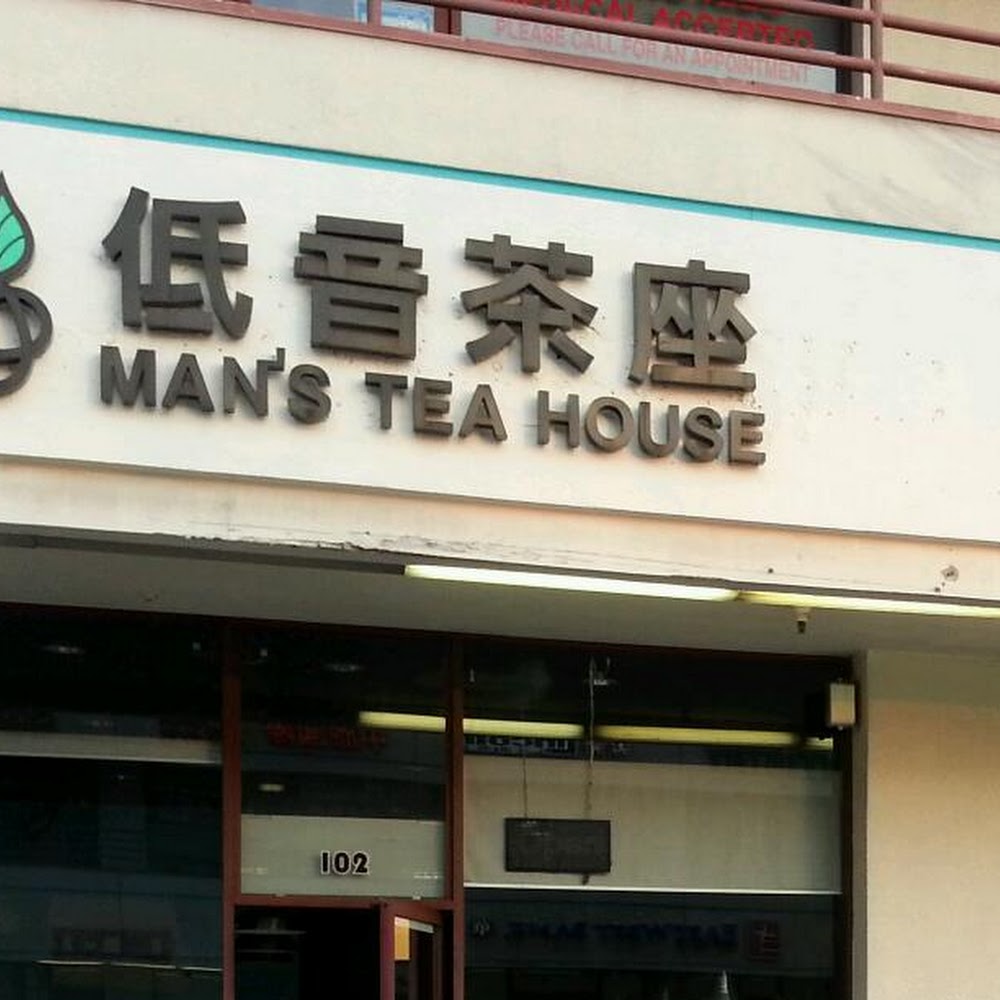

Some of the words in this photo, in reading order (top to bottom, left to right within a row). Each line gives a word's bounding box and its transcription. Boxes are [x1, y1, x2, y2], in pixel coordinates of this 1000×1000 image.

[496, 17, 566, 46] PLEASE
[570, 30, 614, 54] CALL
[622, 37, 657, 60] FOR
[661, 43, 686, 66] AN
[689, 48, 811, 84] APPOINTMENT
[101, 185, 758, 396] 低音茶座
[99, 344, 332, 424] MAN'S
[363, 370, 508, 442] TEA
[535, 389, 766, 466] HOUSE
[319, 850, 371, 877] 102
